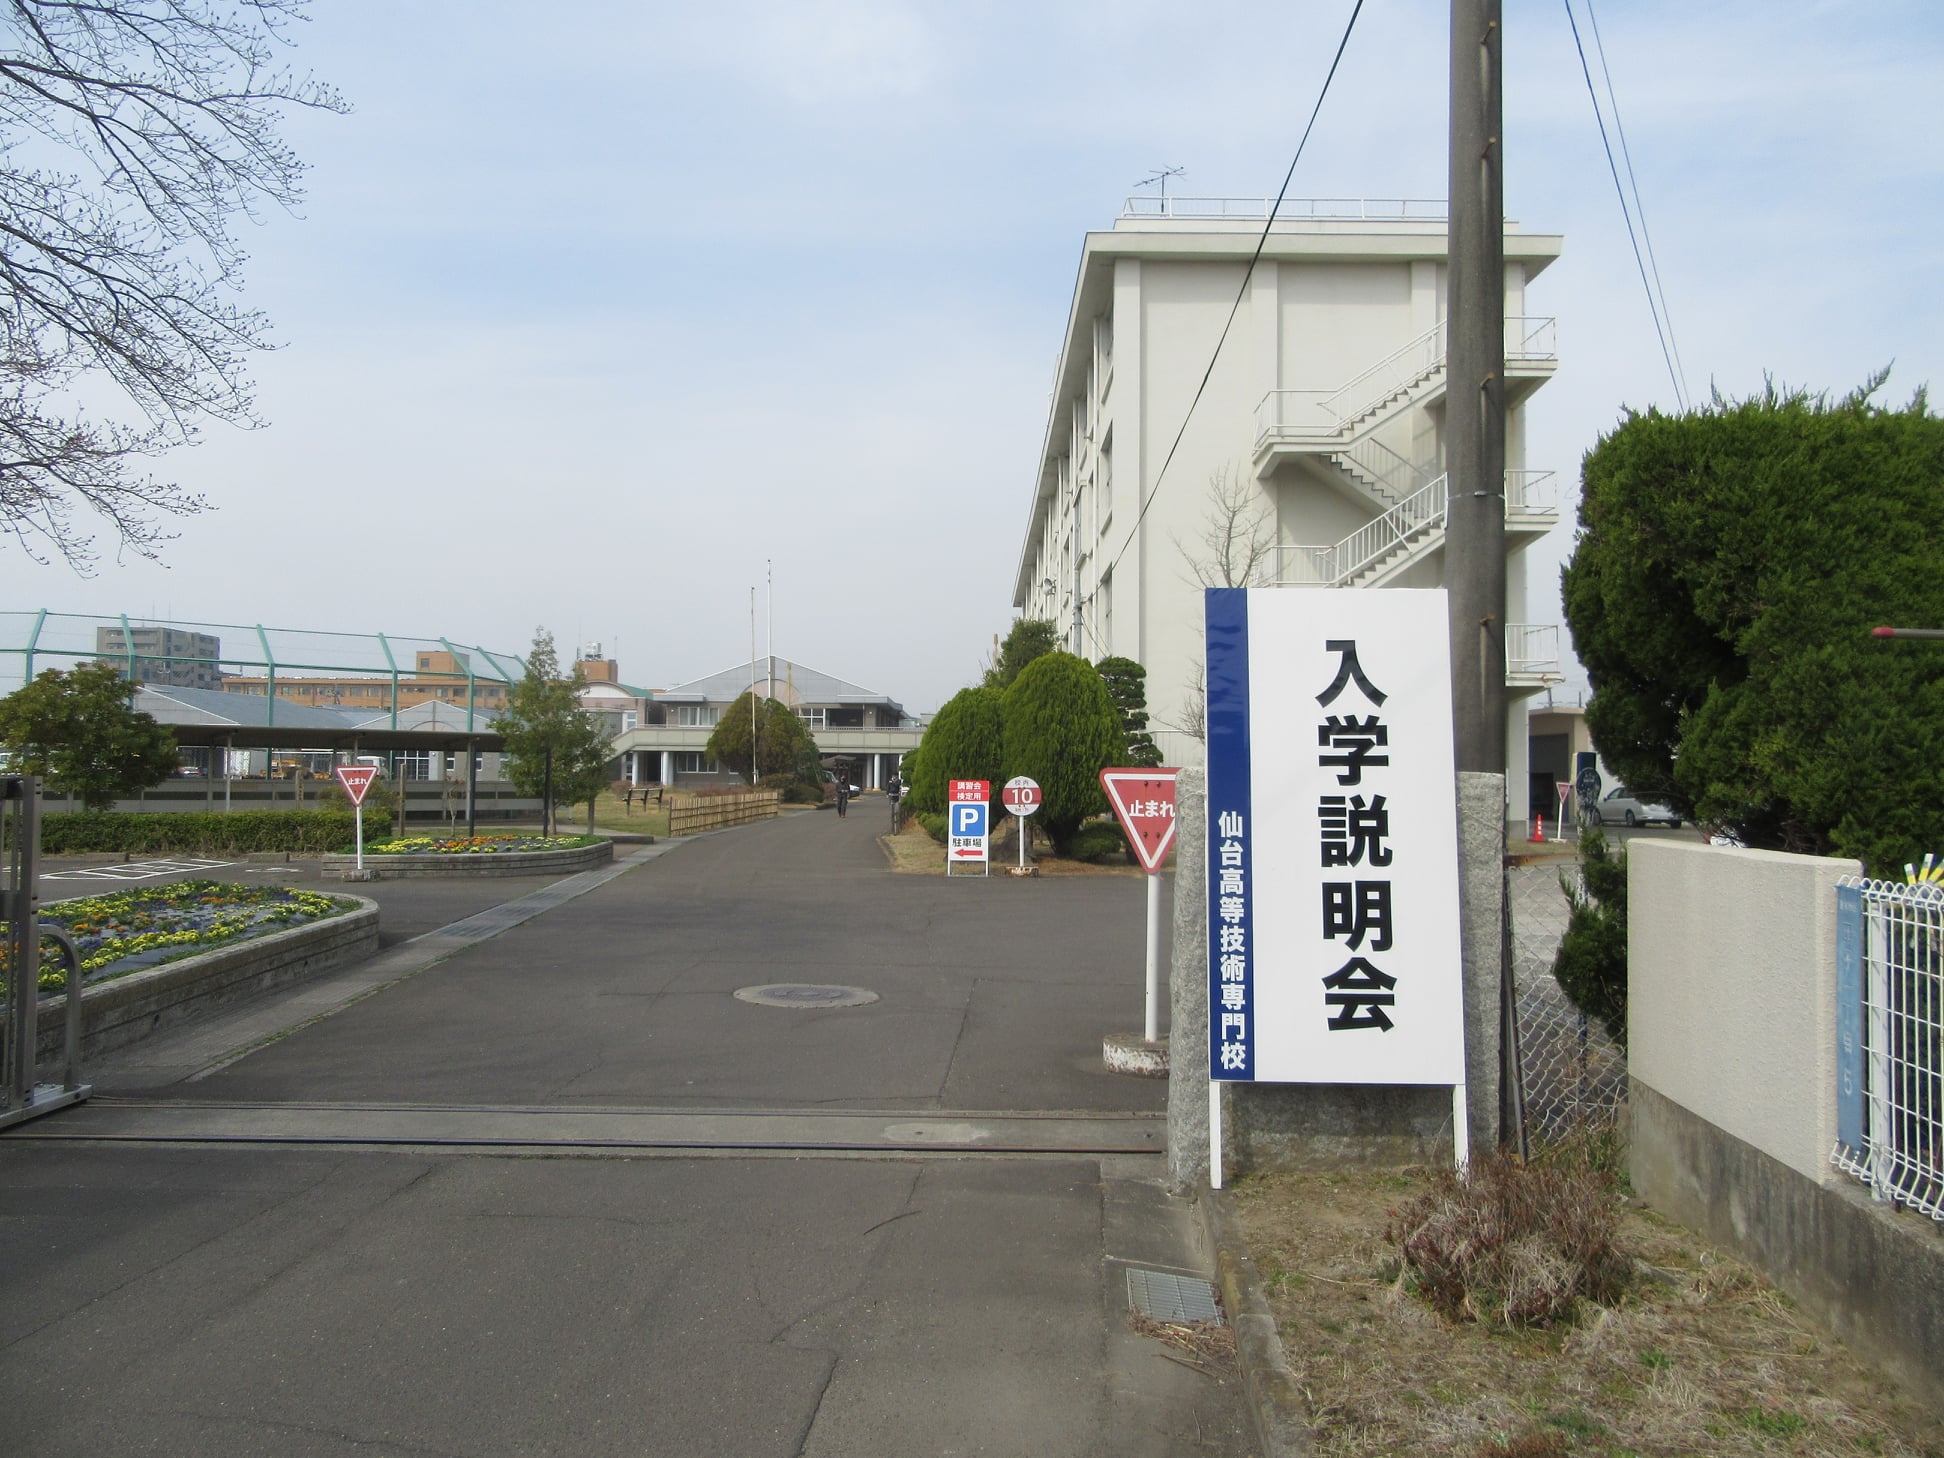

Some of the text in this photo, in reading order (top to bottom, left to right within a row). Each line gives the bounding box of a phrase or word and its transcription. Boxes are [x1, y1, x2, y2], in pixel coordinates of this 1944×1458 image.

[957, 781, 982, 790] 講習会
[957, 792, 981, 801] 検定用
[1011, 788, 1033, 804] 10
[1128, 799, 1176, 818] 止まれ
[960, 808, 979, 832] P
[952, 838, 982, 848] 駐車場
[1315, 639, 1398, 1032] 入学説明会
[1218, 811, 1247, 1070] 仙台高等技術専門校
